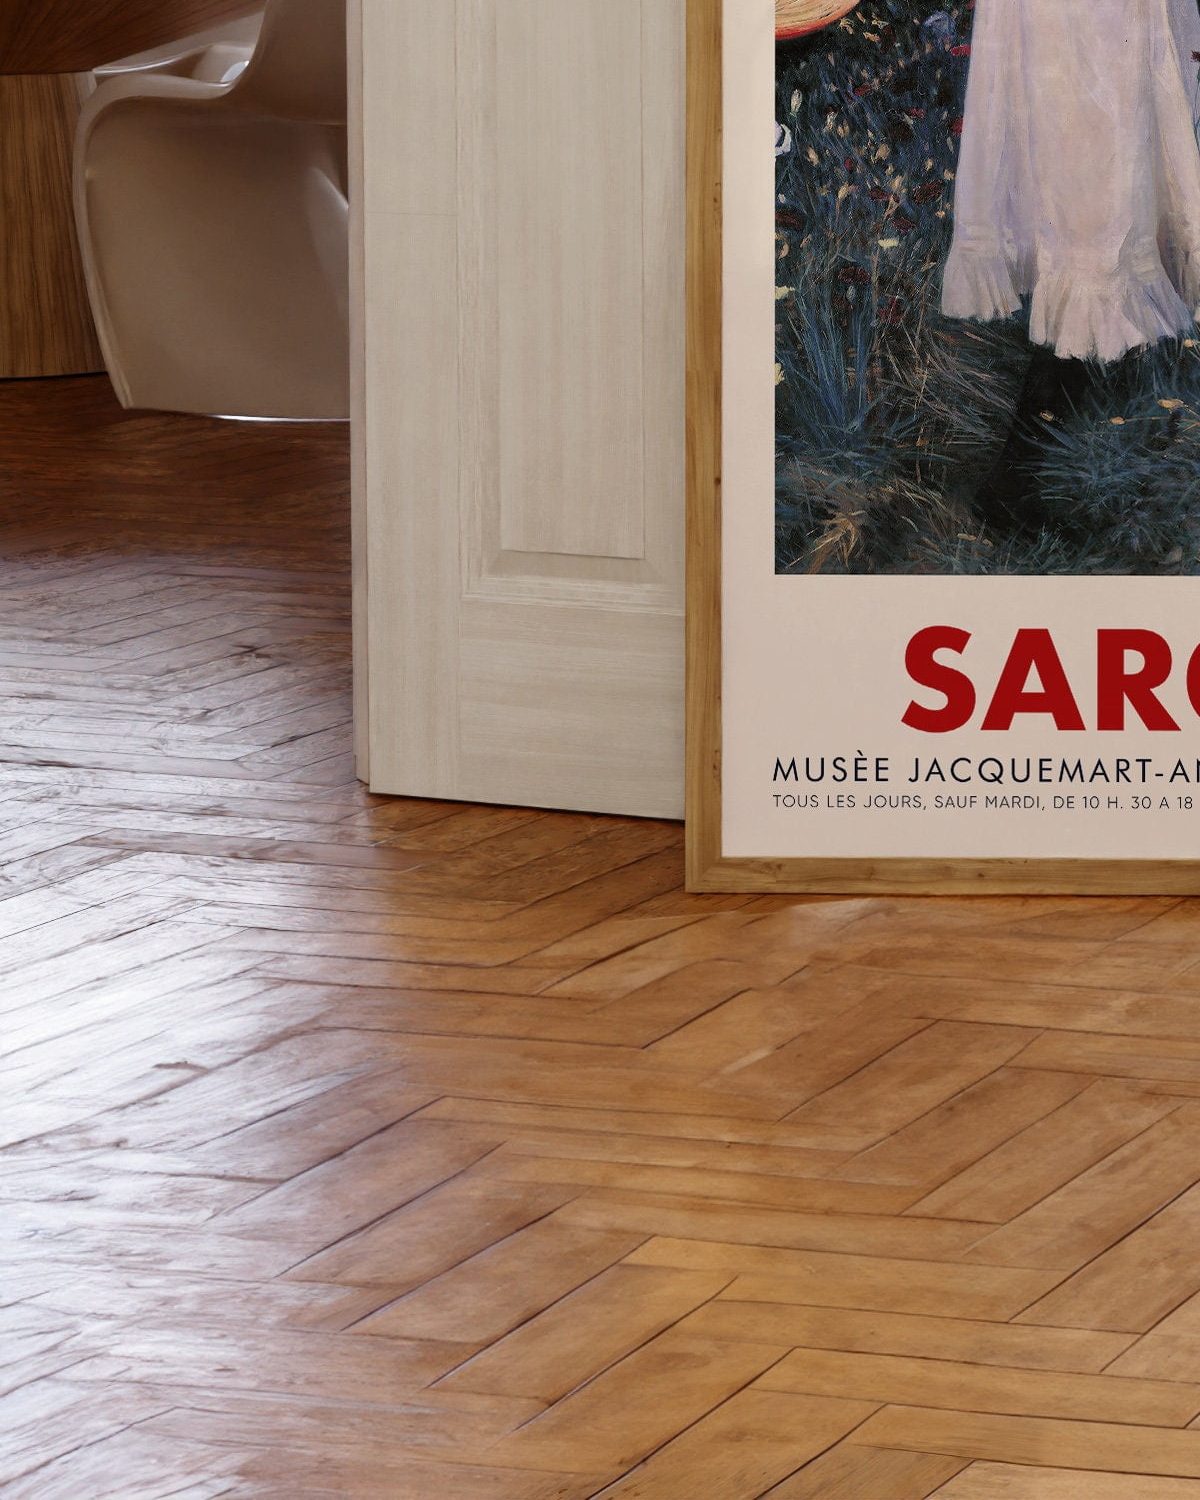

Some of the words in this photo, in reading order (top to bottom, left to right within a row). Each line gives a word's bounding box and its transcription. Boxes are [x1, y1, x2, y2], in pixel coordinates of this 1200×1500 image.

[773, 750, 889, 782] MUSÈE
[773, 795, 818, 808] TOUS
[828, 795, 855, 808] LES
[864, 795, 926, 811] JOURS,
[935, 795, 977, 808] SAUF
[986, 796, 1044, 811] MARDI,
[1054, 796, 1074, 809] DE
[1083, 796, 1099, 809] 10
[1108, 796, 1123, 809] H.
[1131, 796, 1151, 809] 30
[1159, 797, 1169, 809] A
[1177, 796, 1192, 809] 18
